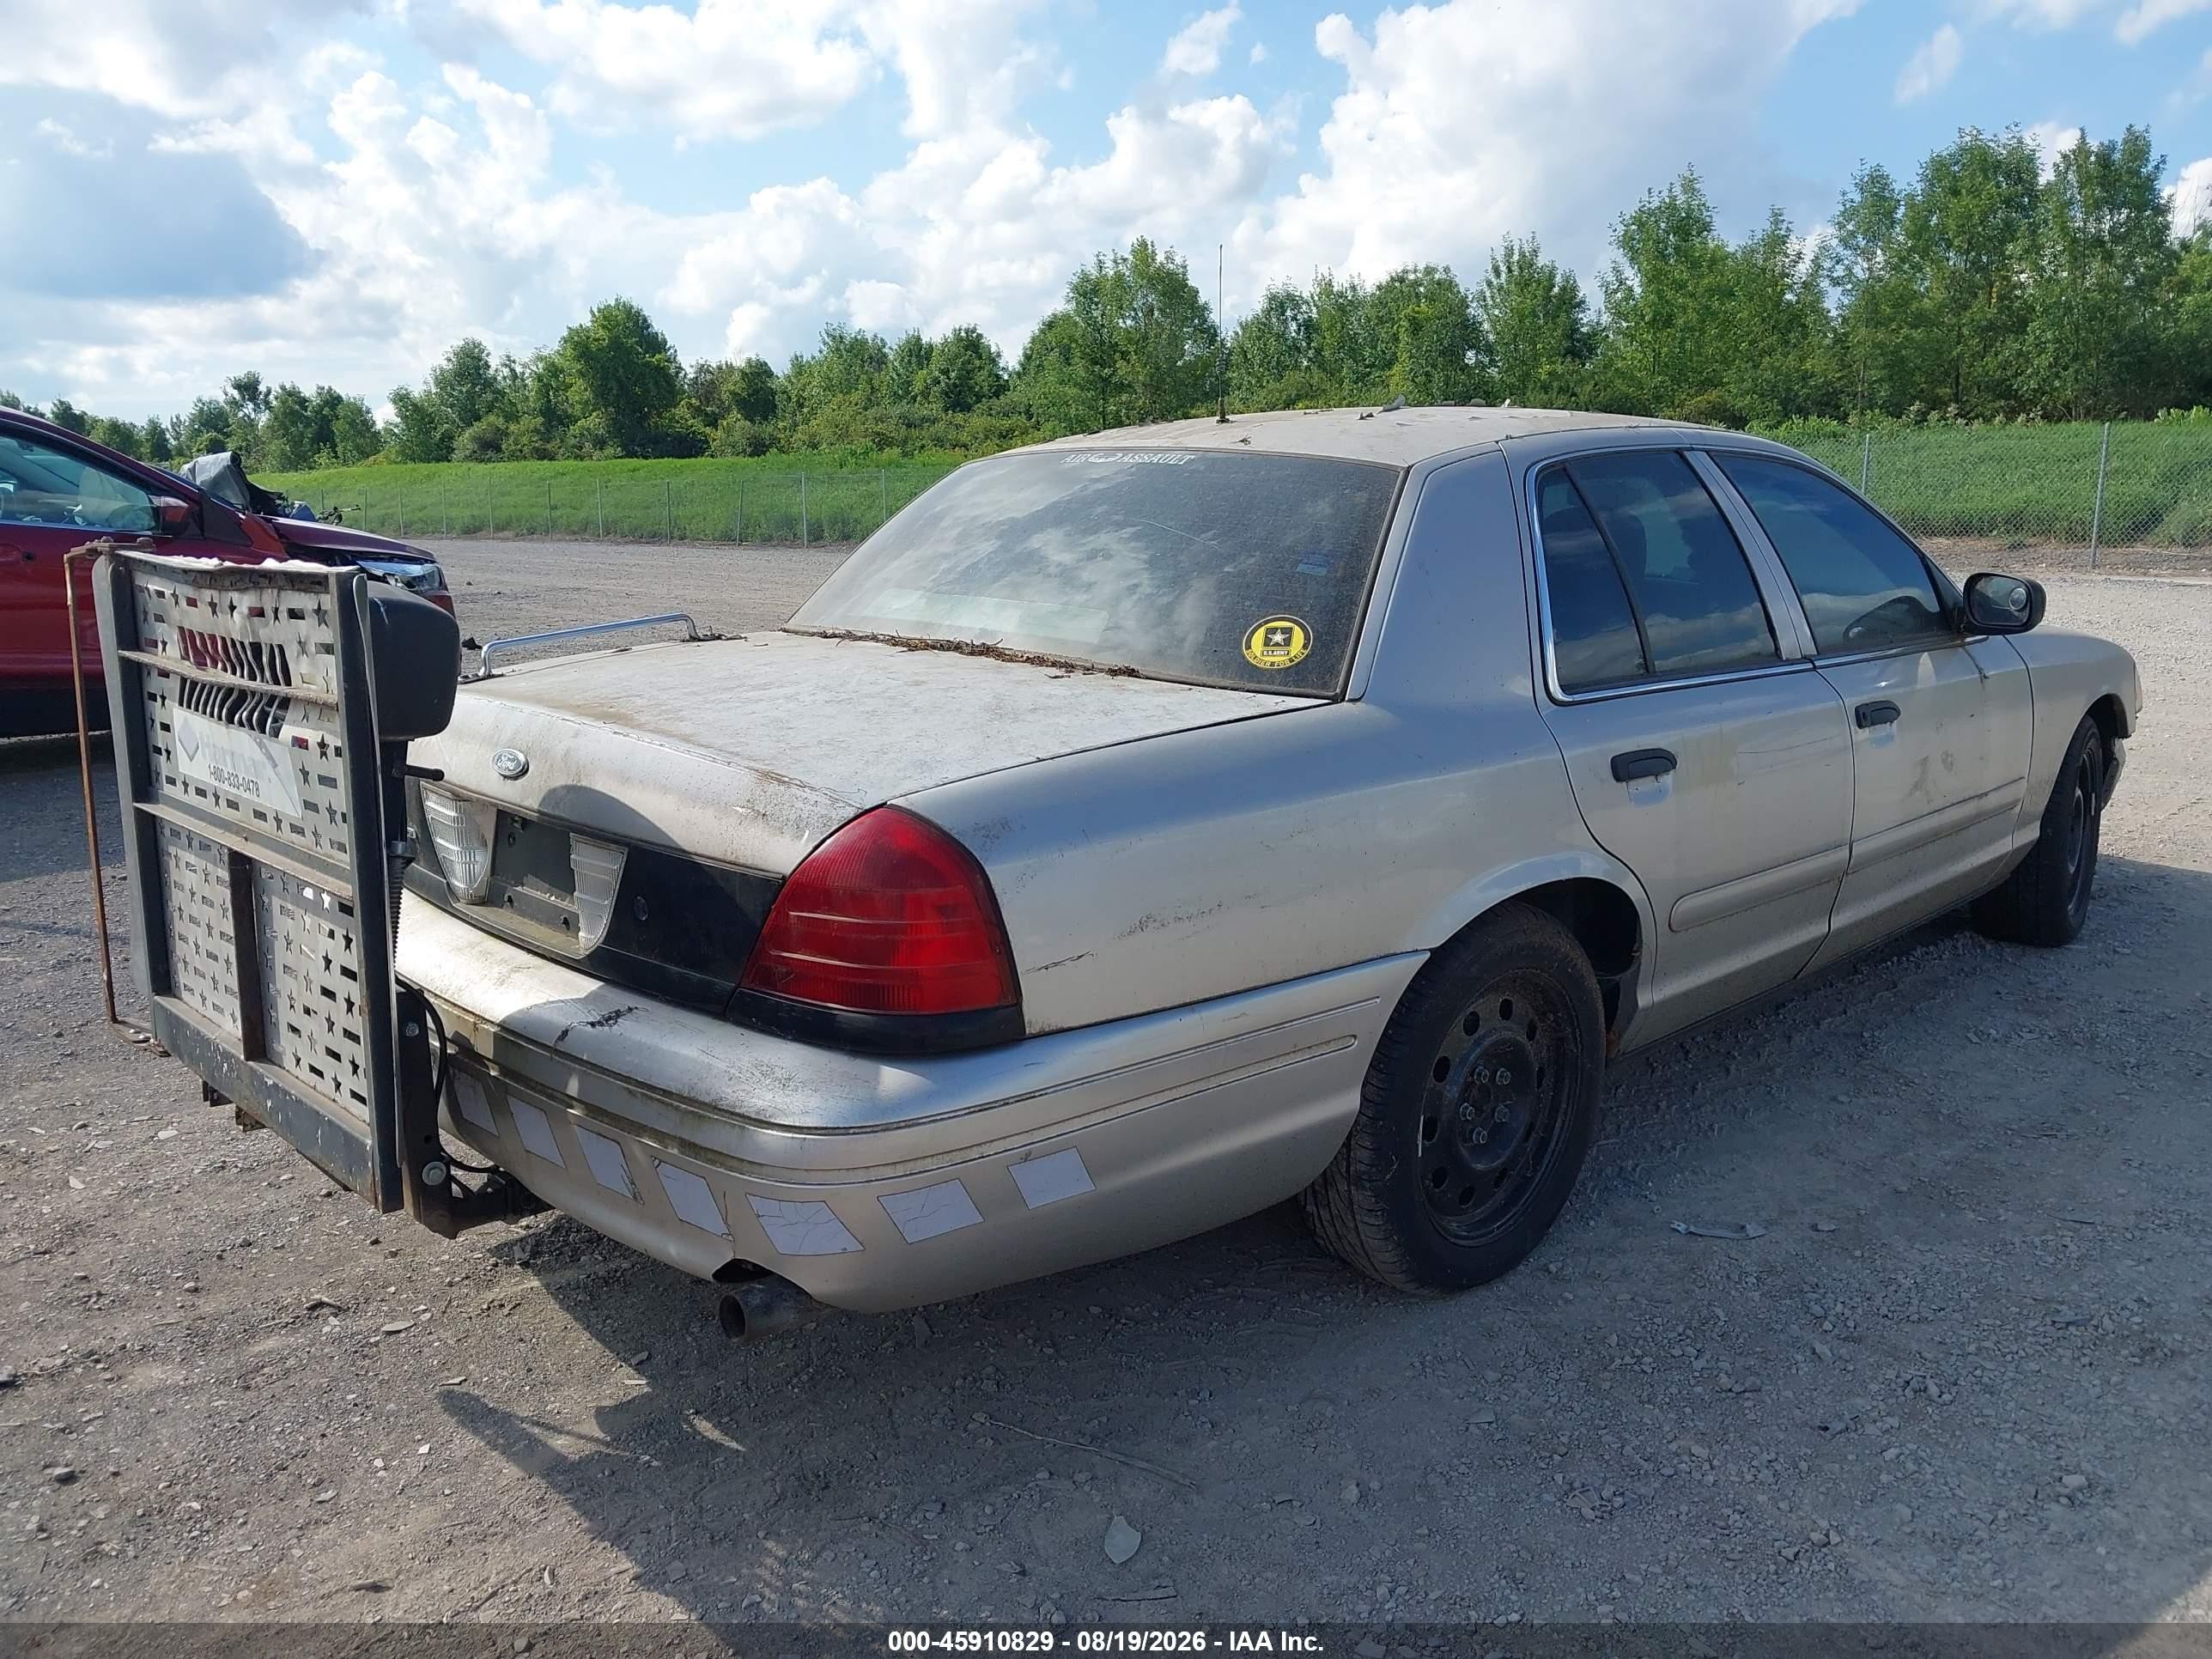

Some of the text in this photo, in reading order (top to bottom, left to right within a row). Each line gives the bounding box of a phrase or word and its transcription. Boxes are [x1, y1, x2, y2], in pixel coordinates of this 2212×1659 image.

[1061, 453, 1195, 465] AIR ASSAULT
[1246, 648, 1307, 667] SOLDIER FOR LIFE
[497, 752, 517, 770] Ford
[208, 762, 260, 797] 1-800-833-0478
